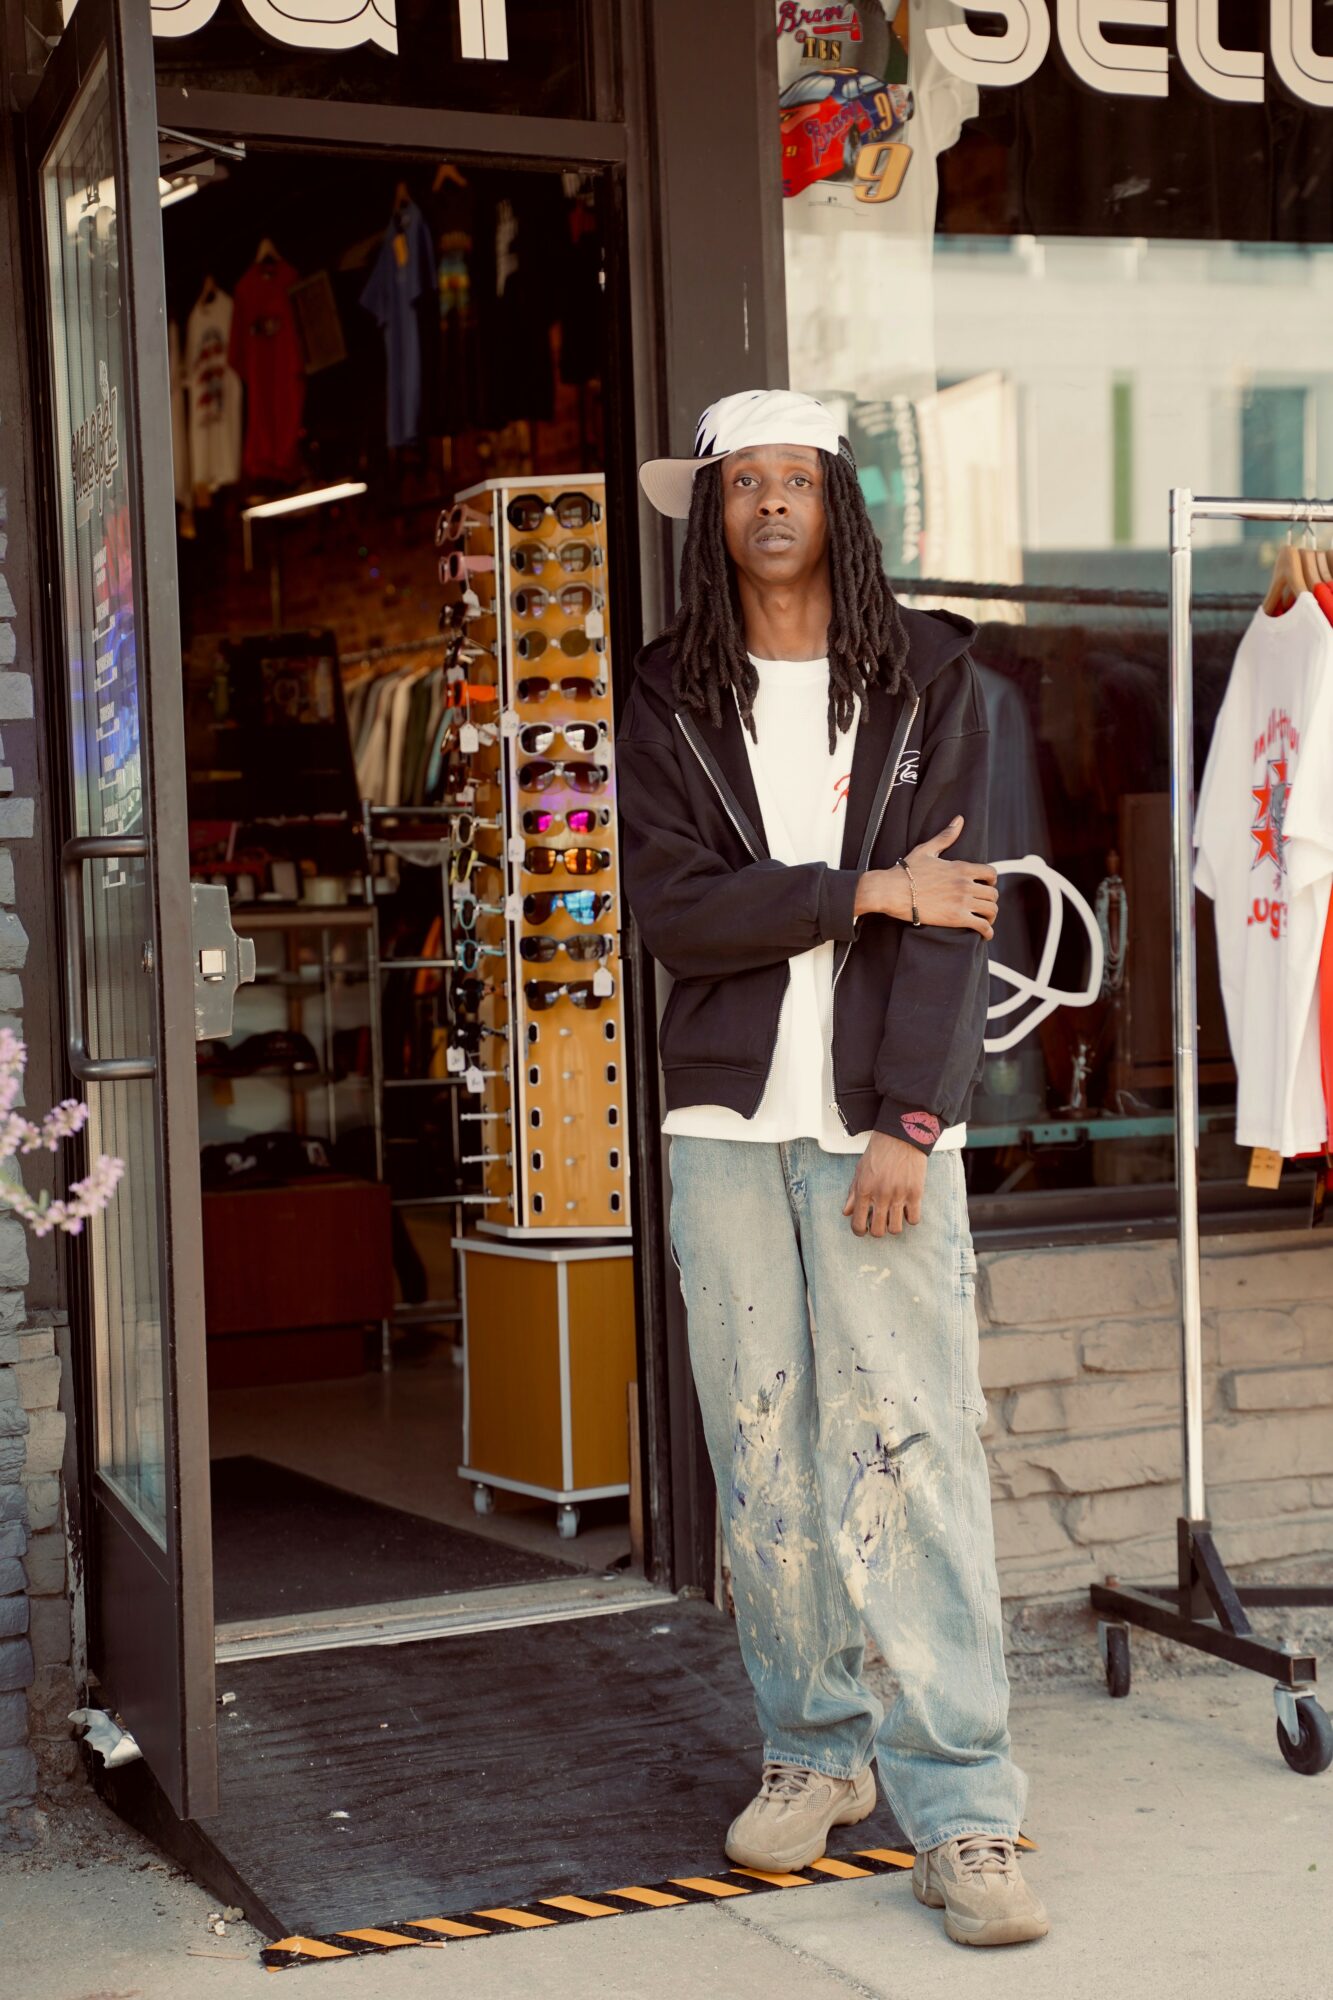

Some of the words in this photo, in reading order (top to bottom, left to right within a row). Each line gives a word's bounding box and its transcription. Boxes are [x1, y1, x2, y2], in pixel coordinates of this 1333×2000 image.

[805, 37, 840, 60] TBS
[872, 92, 893, 132] 9
[854, 142, 914, 204] 9
